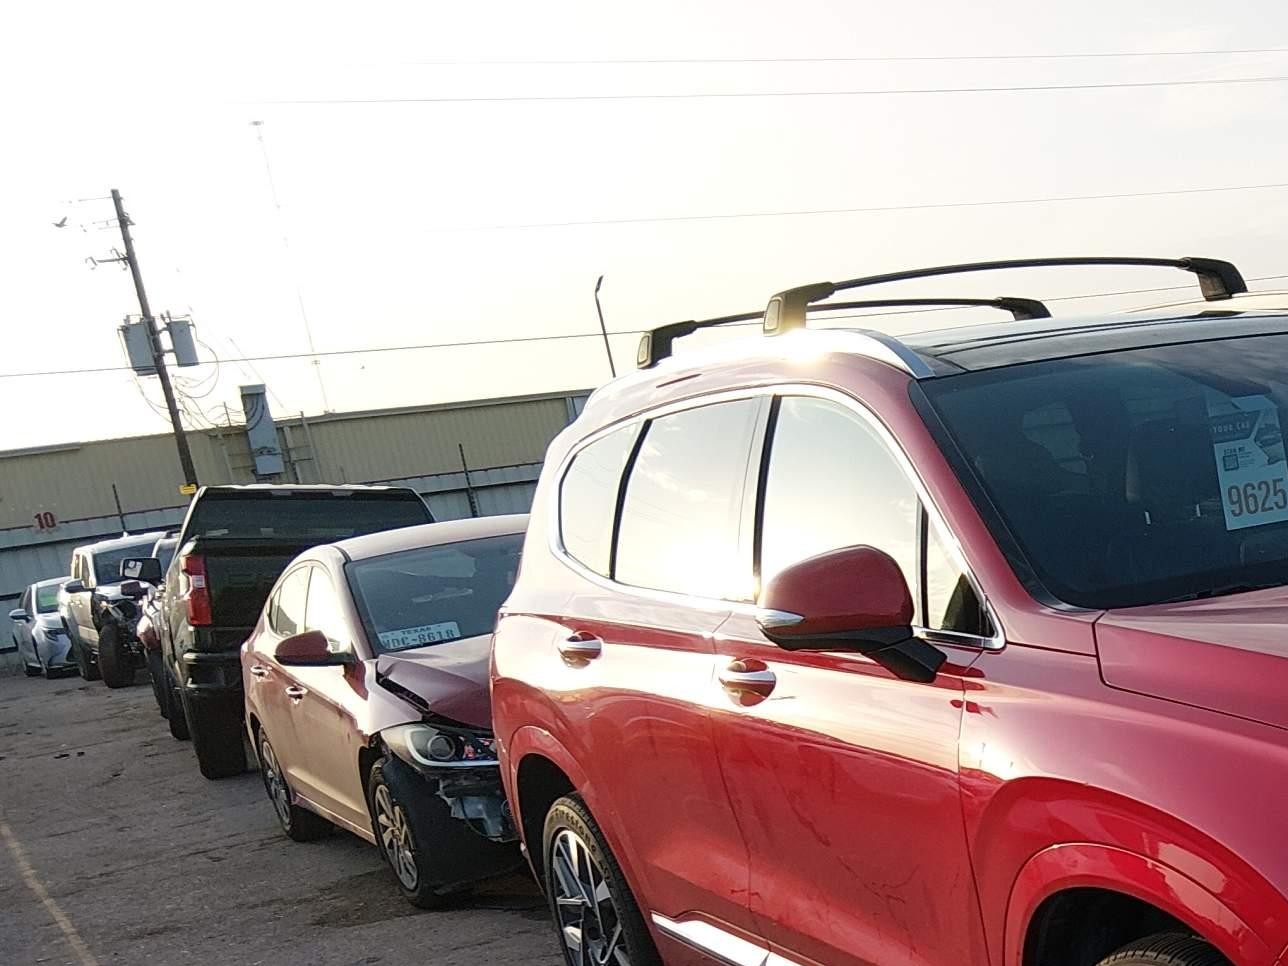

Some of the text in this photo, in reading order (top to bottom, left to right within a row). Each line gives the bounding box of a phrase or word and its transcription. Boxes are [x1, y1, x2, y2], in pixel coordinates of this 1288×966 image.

[1227, 478, 1288, 518] 9625
[34, 511, 56, 529] 10
[401, 626, 432, 636] TEXAS
